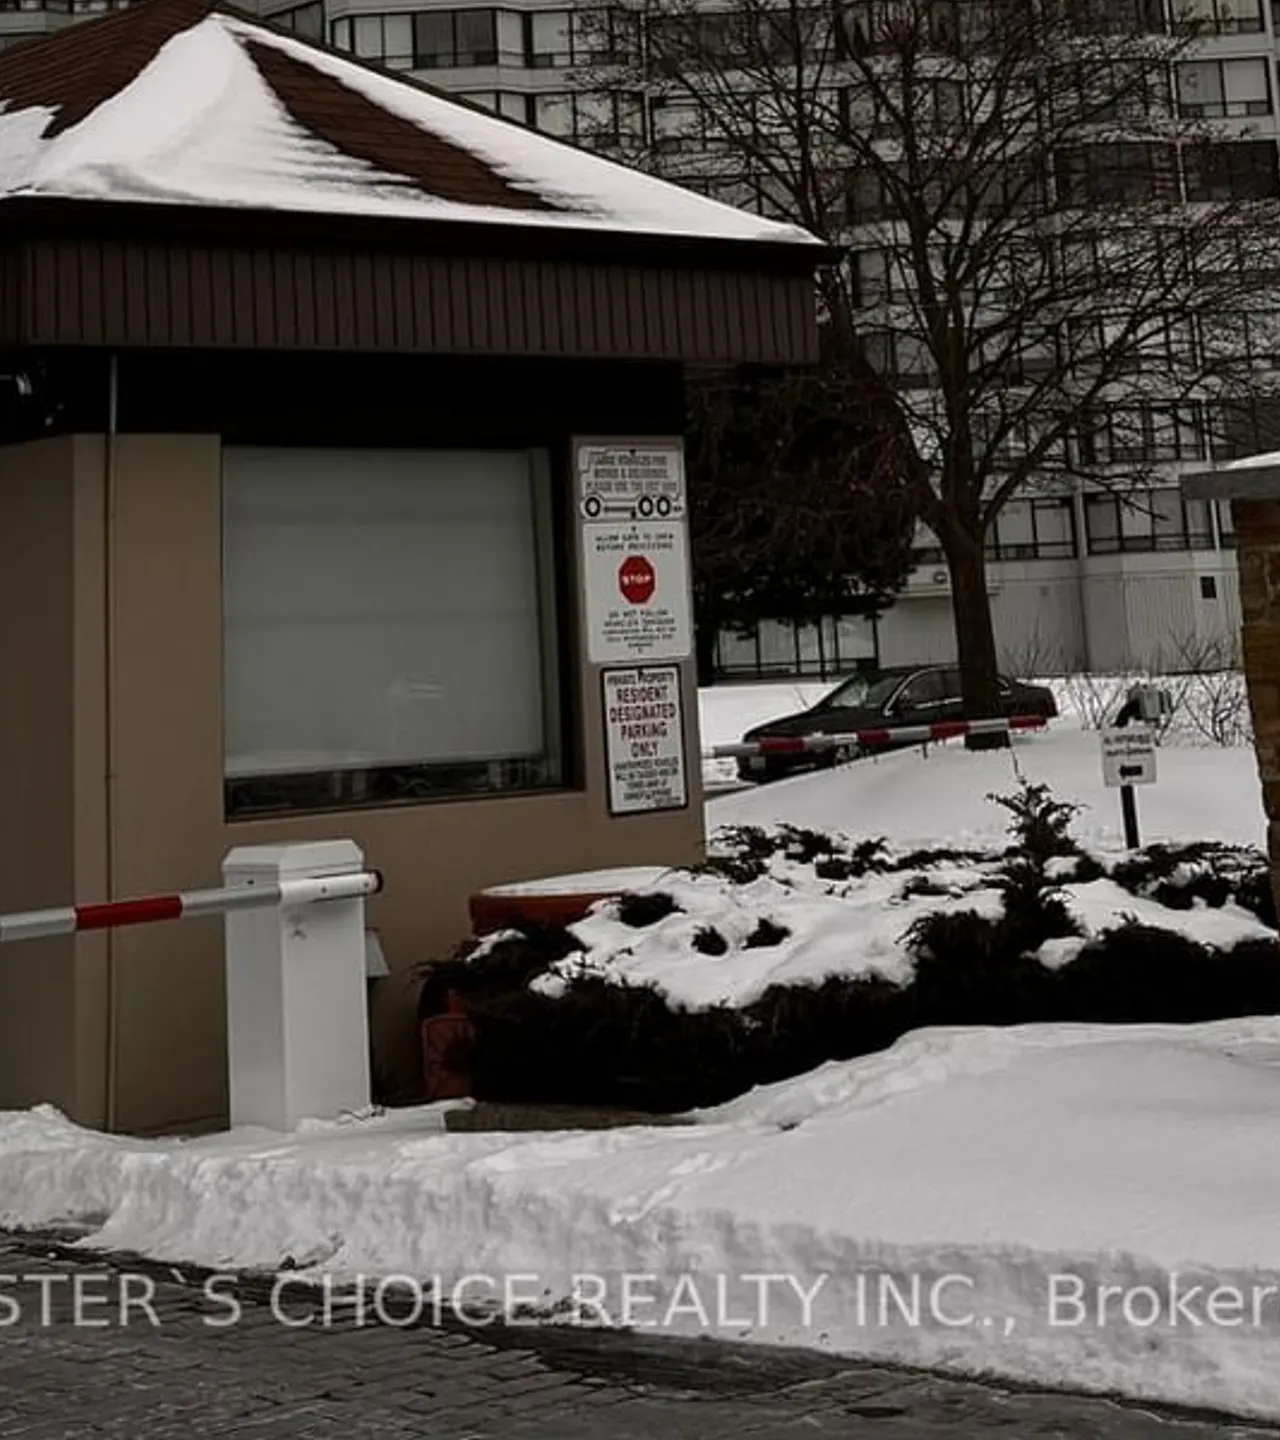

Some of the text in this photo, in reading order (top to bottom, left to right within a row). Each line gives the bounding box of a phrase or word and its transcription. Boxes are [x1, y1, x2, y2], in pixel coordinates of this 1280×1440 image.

[621, 574, 652, 586] STOP
[617, 685, 668, 704] RESIDENT
[610, 702, 677, 723] DESIGNATED
[621, 721, 668, 740] PARKING
[631, 742, 658, 758] ONLY
